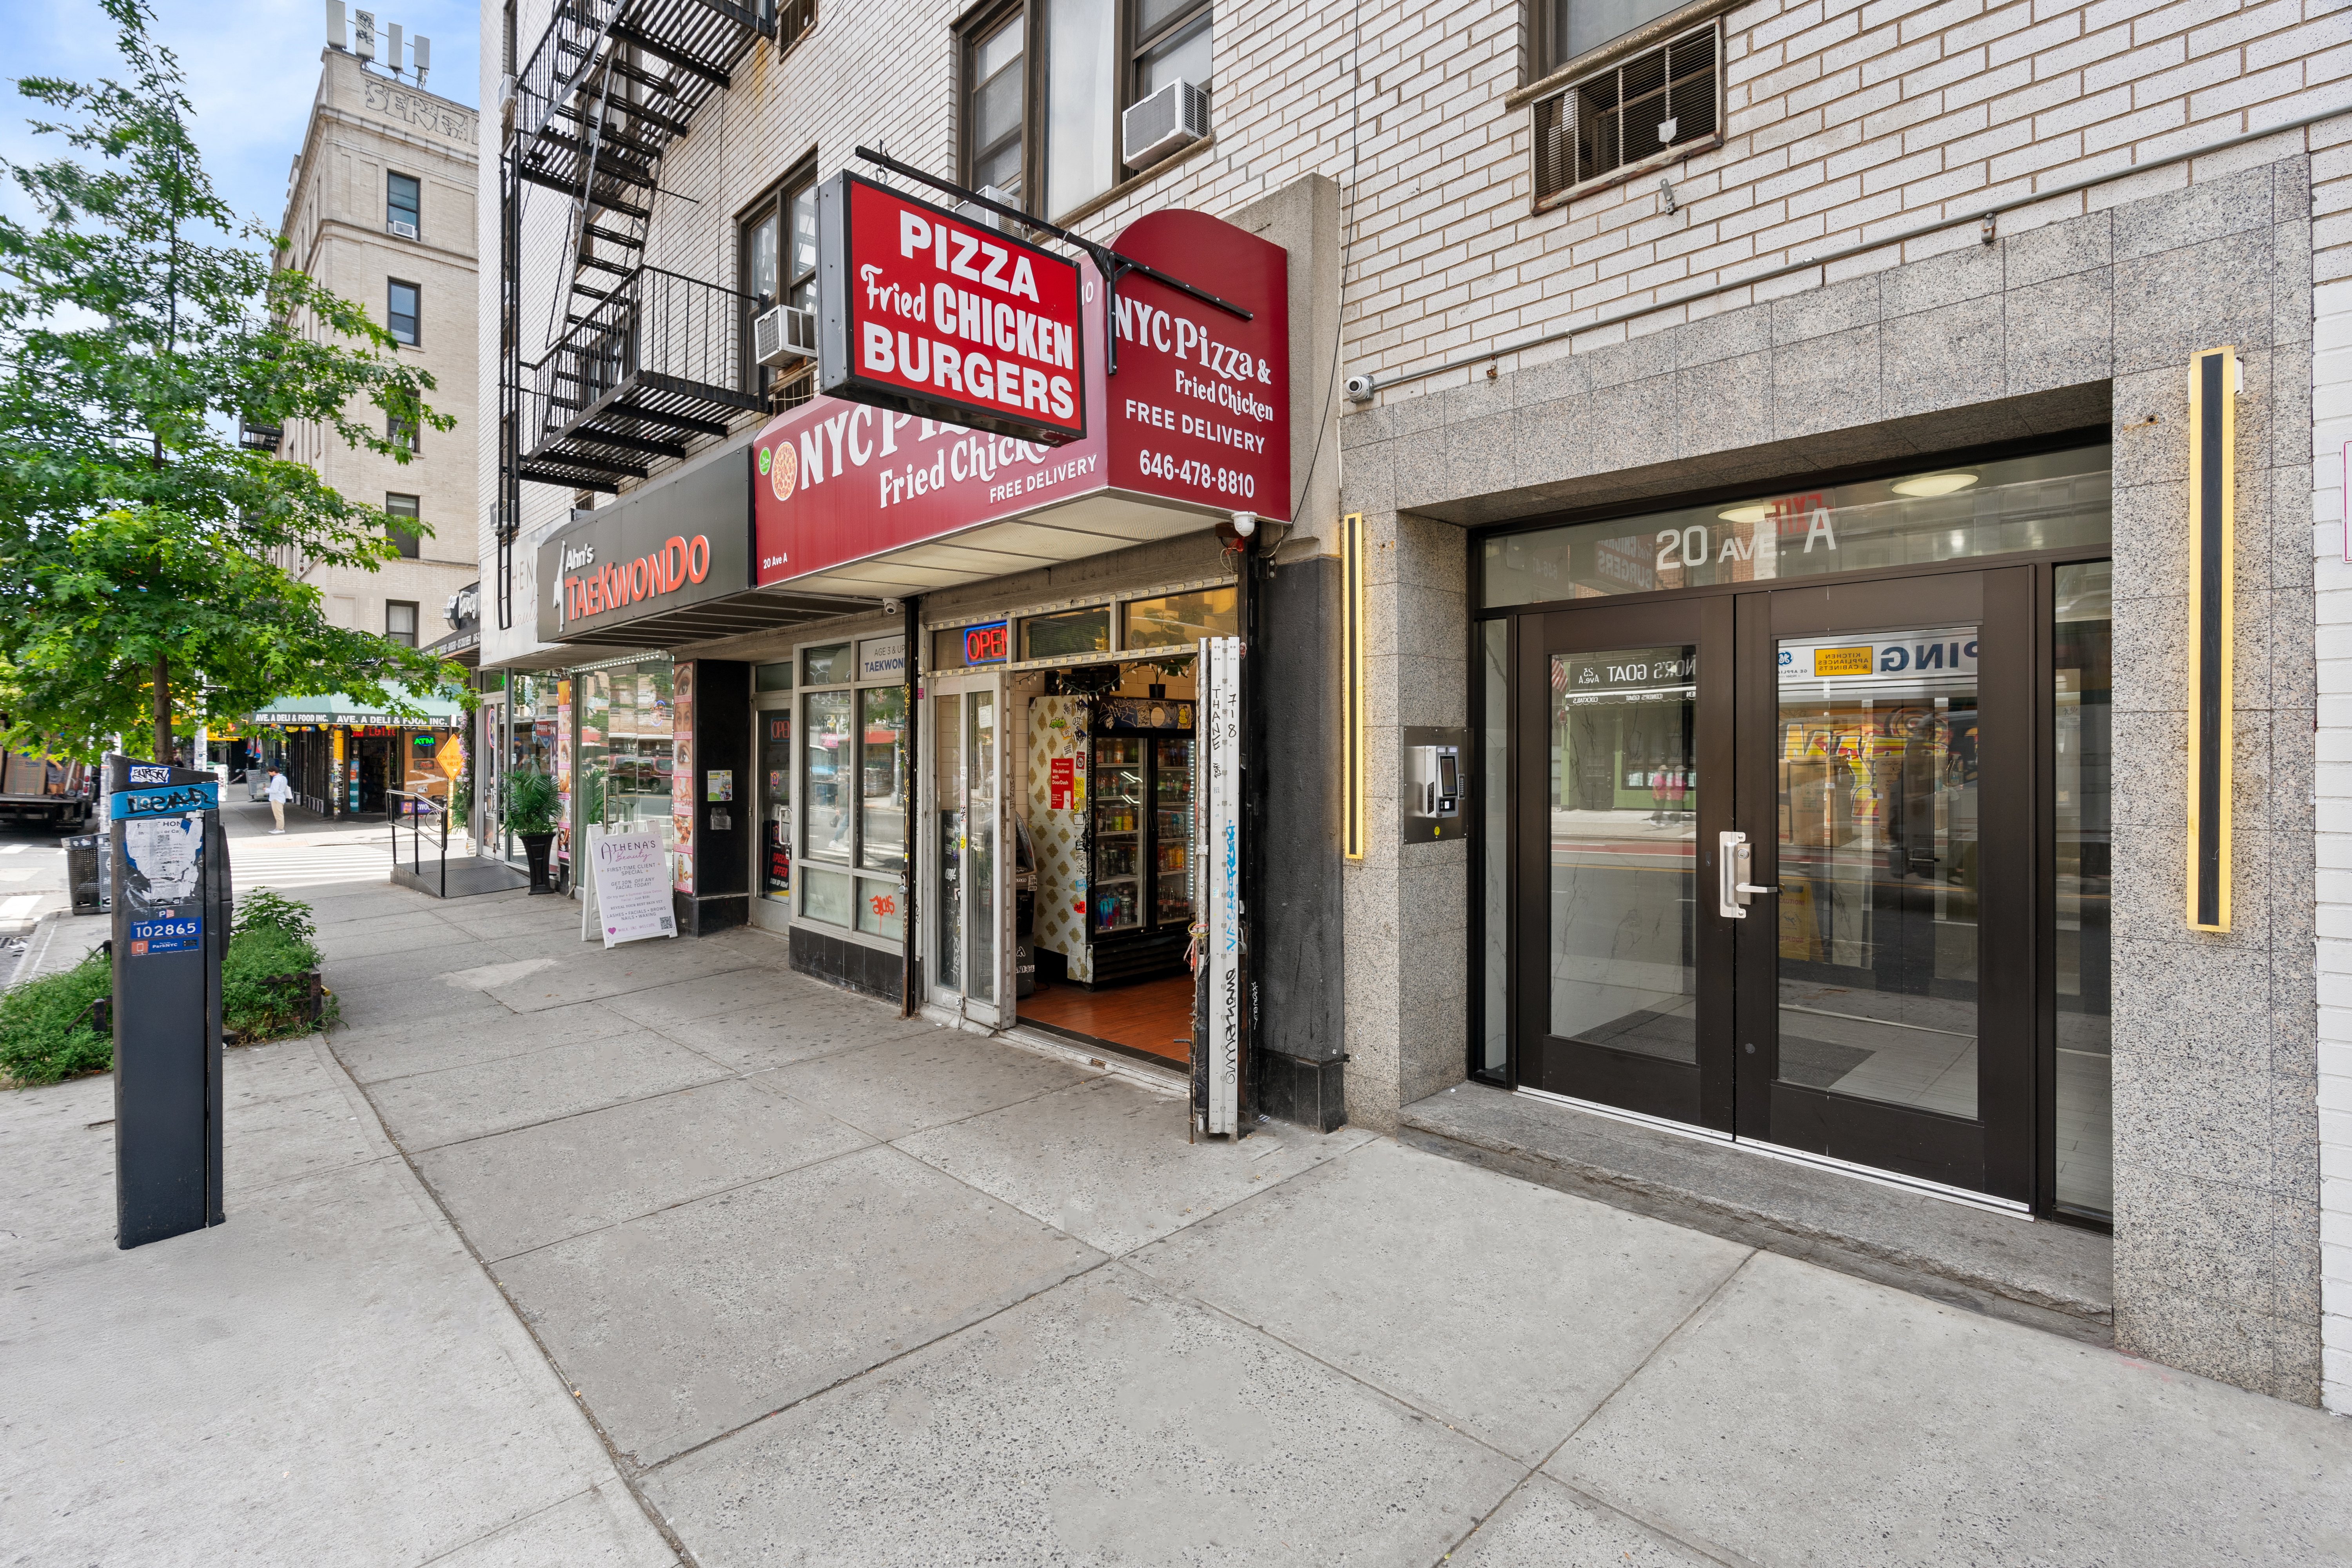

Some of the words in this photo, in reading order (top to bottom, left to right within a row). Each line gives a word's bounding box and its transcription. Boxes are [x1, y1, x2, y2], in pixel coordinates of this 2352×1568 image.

[900, 209, 1040, 303] PIZZA
[860, 263, 926, 323] Fried
[933, 282, 1074, 370] CHICKEN
[1115, 294, 1171, 352] NYC
[1174, 318, 1254, 381] Pizza
[1257, 359, 1271, 385] &
[863, 321, 1074, 419] BURGERS
[1175, 368, 1216, 403] Fried
[1218, 383, 1273, 422] Chicken
[800, 404, 873, 490] NYC
[1126, 399, 1175, 431] FREE
[1182, 414, 1265, 454] DELIVERY
[880, 449, 945, 509] Fried
[950, 432, 1051, 482] Chick
[989, 481, 1022, 504] FREE
[1026, 454, 1097, 492] DELIVERY
[1140, 449, 1254, 498] 646-478-8810
[565, 543, 594, 572] Ahn's
[763, 558, 771, 569] 20
[772, 556, 782, 567] Ave
[783, 552, 788, 563] A
[1656, 525, 1708, 571] 20
[1718, 532, 1787, 563] AVE.
[1803, 507, 1837, 554] A
[564, 535, 710, 621] TAEKWONDO
[864, 657, 905, 673] TAEKWON
[874, 647, 886, 657] AGE
[897, 644, 905, 653] UP
[255, 714, 270, 722] AVE.
[537, 723, 548, 732] Happy
[772, 721, 789, 738] OPE
[1227, 693, 1237, 738] 718
[601, 840, 656, 865] ATHENA'S
[613, 848, 652, 862] Beauty
[773, 865, 788, 877] OFFER
[677, 882, 689, 890] FACIALS
[136, 922, 196, 938] 102865
